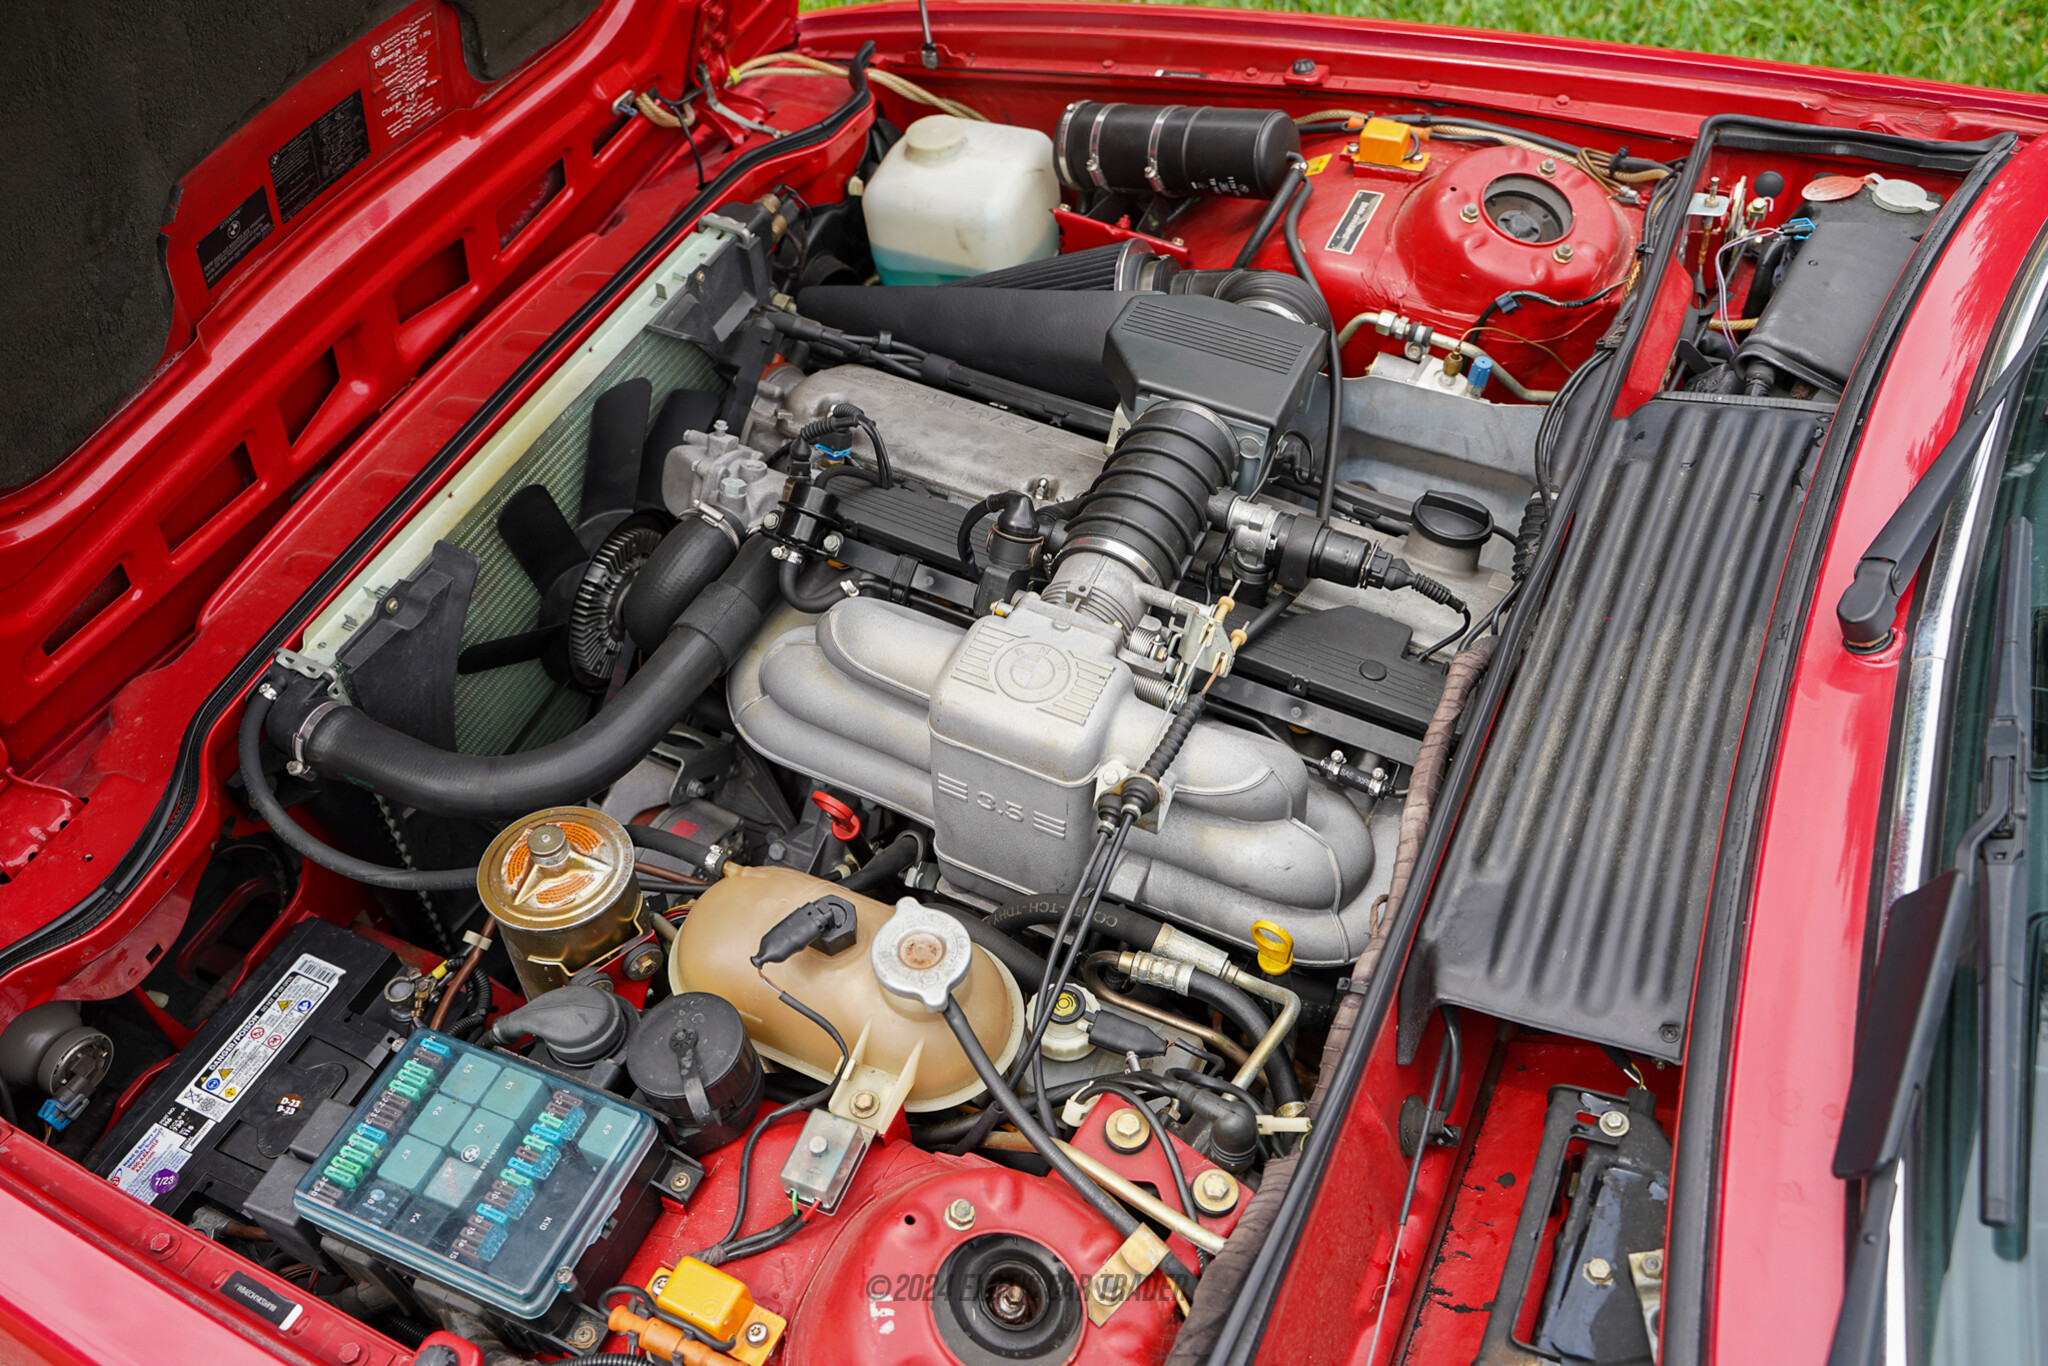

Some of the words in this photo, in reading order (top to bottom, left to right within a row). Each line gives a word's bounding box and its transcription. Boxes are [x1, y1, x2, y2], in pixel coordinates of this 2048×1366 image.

[1340, 769, 1354, 780] SAE
[976, 790, 1025, 822] 3.5
[208, 1013, 260, 1071] DANGER/POISON
[463, 1064, 474, 1073] K5
[505, 1081, 514, 1090] K1
[281, 1097, 301, 1106] D-23
[276, 1106, 295, 1115] 9-23
[432, 1106, 445, 1116] K6
[162, 1116, 172, 1126] H6
[172, 1119, 185, 1131] 730
[474, 1123, 485, 1134] K2
[602, 1124, 614, 1135] K9
[122, 1153, 135, 1166] Need
[137, 1133, 154, 1149] Battery
[401, 1150, 412, 1160] K7
[126, 1147, 146, 1168] Warranty
[135, 1150, 155, 1172] AAA.com
[154, 1175, 174, 1186] 7/23
[491, 1191, 501, 1199] 10
[409, 1212, 422, 1224] K4
[538, 1216, 553, 1231] K10
[449, 1250, 459, 1259] 15
